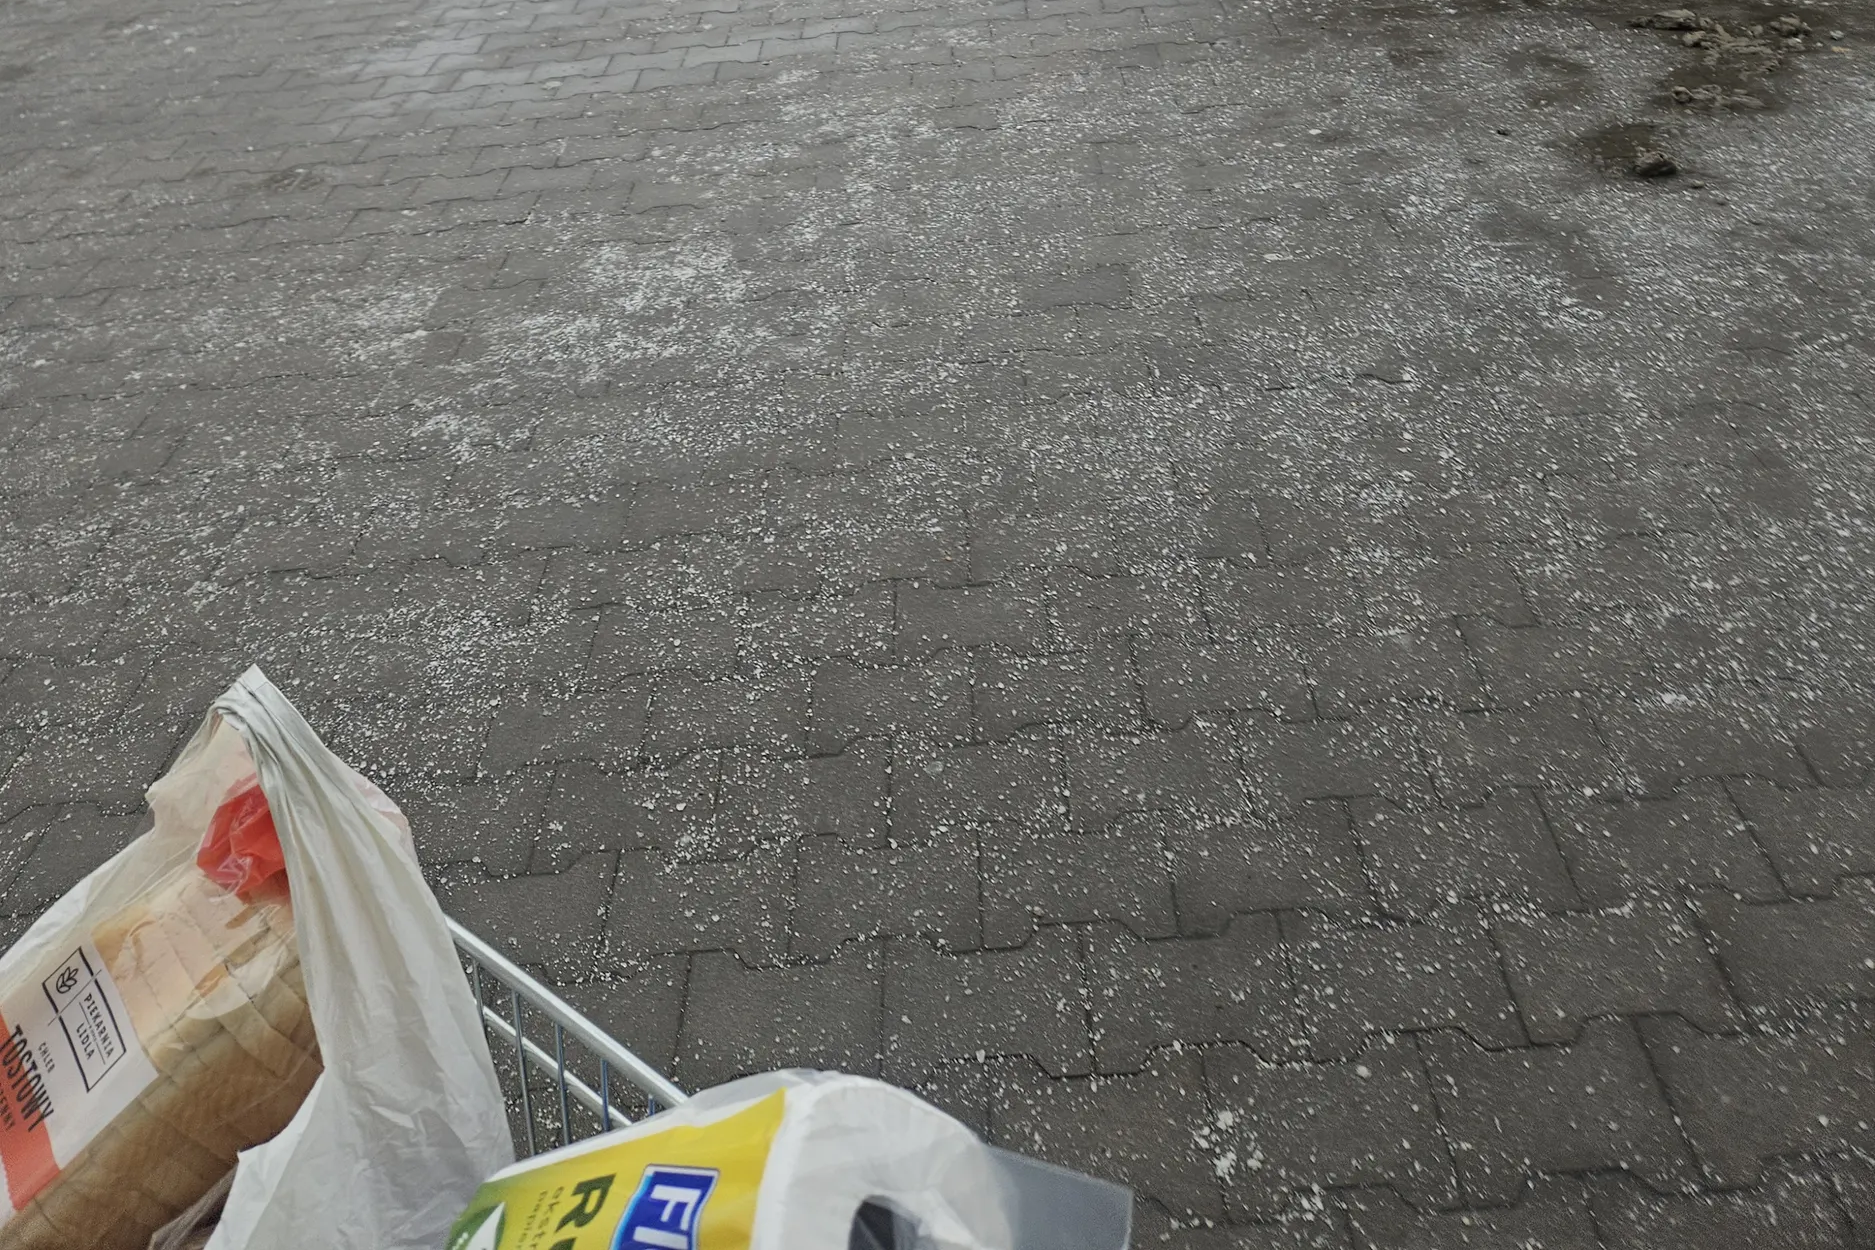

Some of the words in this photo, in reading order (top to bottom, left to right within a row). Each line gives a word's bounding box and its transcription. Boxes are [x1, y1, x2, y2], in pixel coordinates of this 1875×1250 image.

[75, 1022, 96, 1060] LIDLA
[83, 993, 115, 1059] PIEKARNIA
[0, 1023, 55, 1132] TOSTOWY
[632, 1183, 703, 1250] FI
